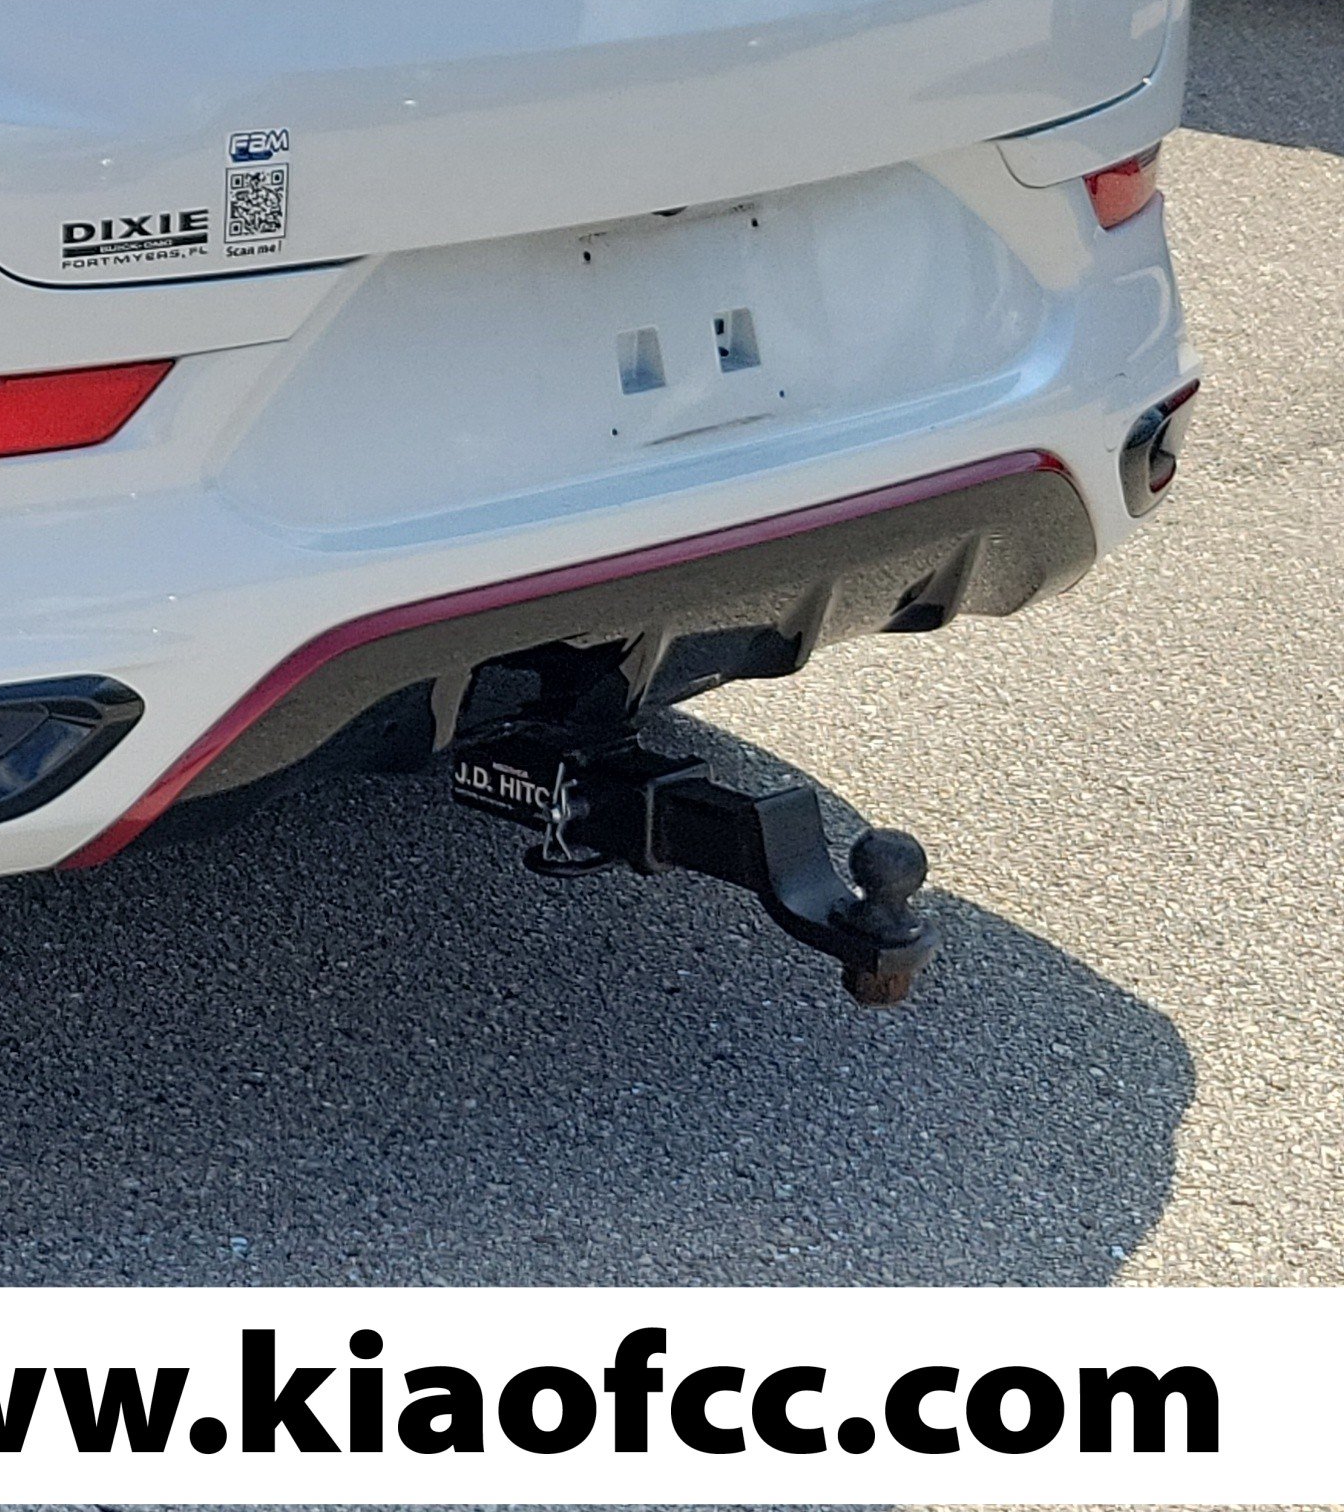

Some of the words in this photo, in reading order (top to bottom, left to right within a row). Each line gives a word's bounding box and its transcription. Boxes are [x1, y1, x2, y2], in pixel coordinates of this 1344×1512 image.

[62, 209, 209, 244] DIXIE
[62, 255, 110, 269] FORT
[189, 246, 209, 256] FL
[226, 246, 255, 258] Scan
[454, 761, 494, 794] J.D.
[500, 774, 554, 811] HITC
